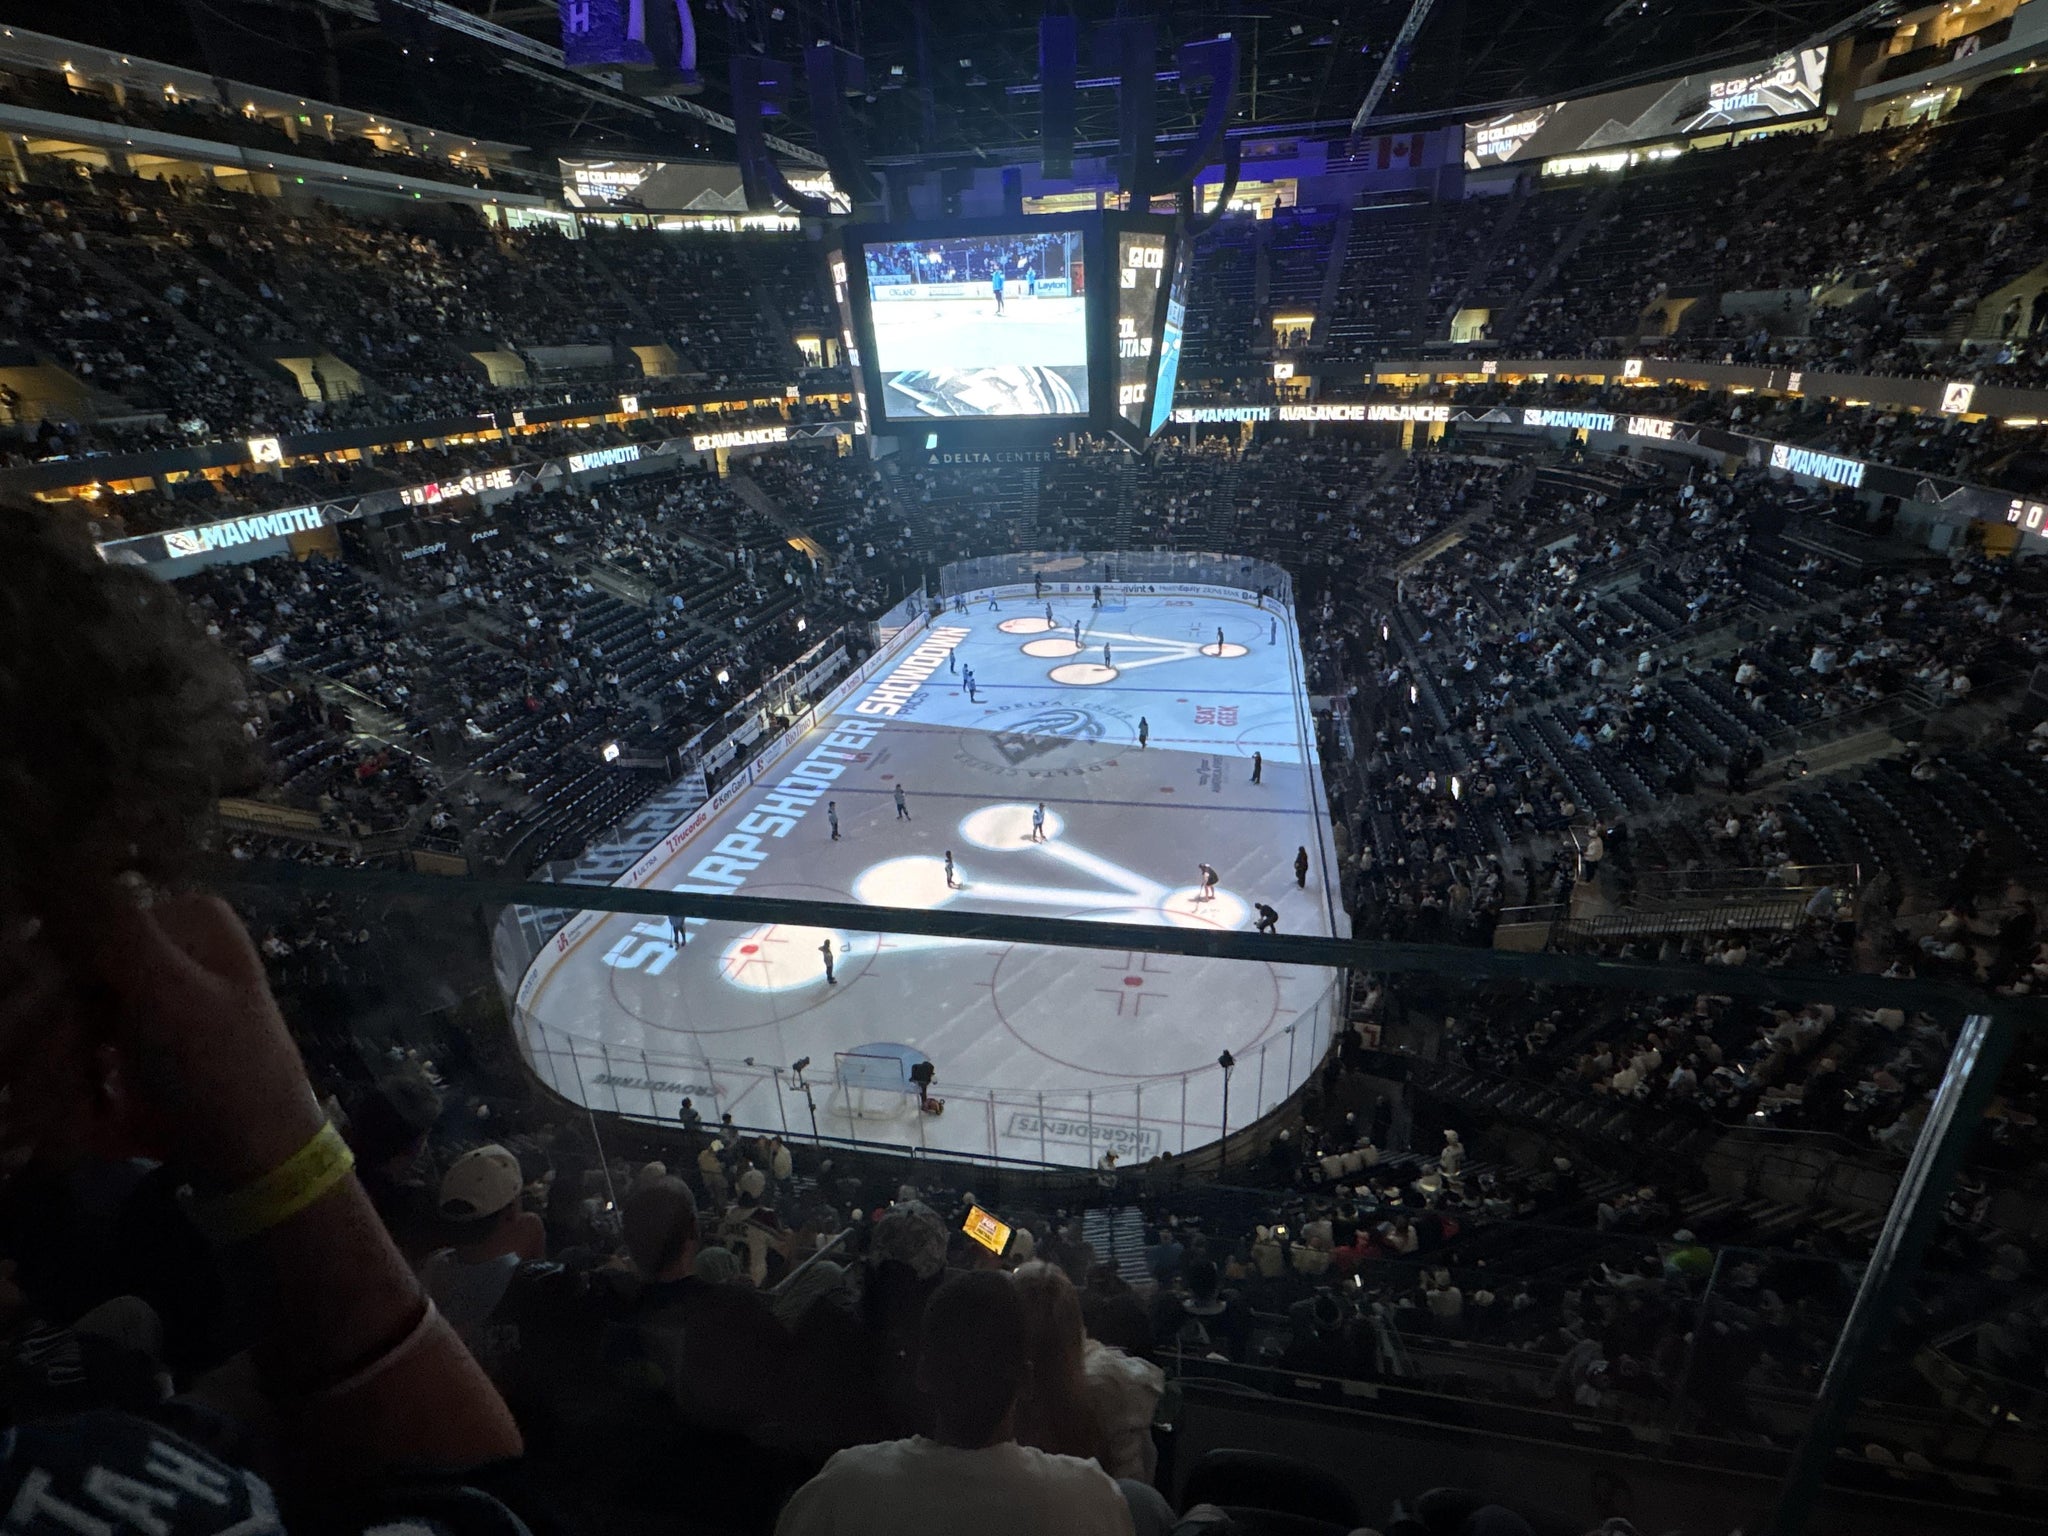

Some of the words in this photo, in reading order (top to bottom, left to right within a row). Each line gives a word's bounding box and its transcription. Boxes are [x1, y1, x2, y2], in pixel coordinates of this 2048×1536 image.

[1724, 92, 1759, 112] UTAH
[1488, 139, 1513, 155] UTAH
[1037, 281, 1068, 293] Layton
[1196, 407, 1271, 422] MAMMOTH
[1279, 404, 1366, 421] AVALANCHE
[1543, 410, 1615, 432] MAMMOTH
[583, 445, 640, 469] MAMMOTH
[943, 453, 992, 465] DELTA
[995, 451, 1052, 463] CENTER
[1787, 446, 1866, 489] MAMMOTH
[2007, 508, 2021, 523] 17
[2026, 505, 2043, 529] 0
[202, 506, 323, 550] MAMMOTH
[855, 626, 972, 716] SHOWDOWN
[1194, 705, 1217, 725] SEAT
[1217, 705, 1240, 727] GEEK
[637, 856, 658, 877] ULTRA
[591, 1073, 717, 1098] CROWDSTRIKE
[1018, 1118, 1150, 1146] INGREDIENTS
